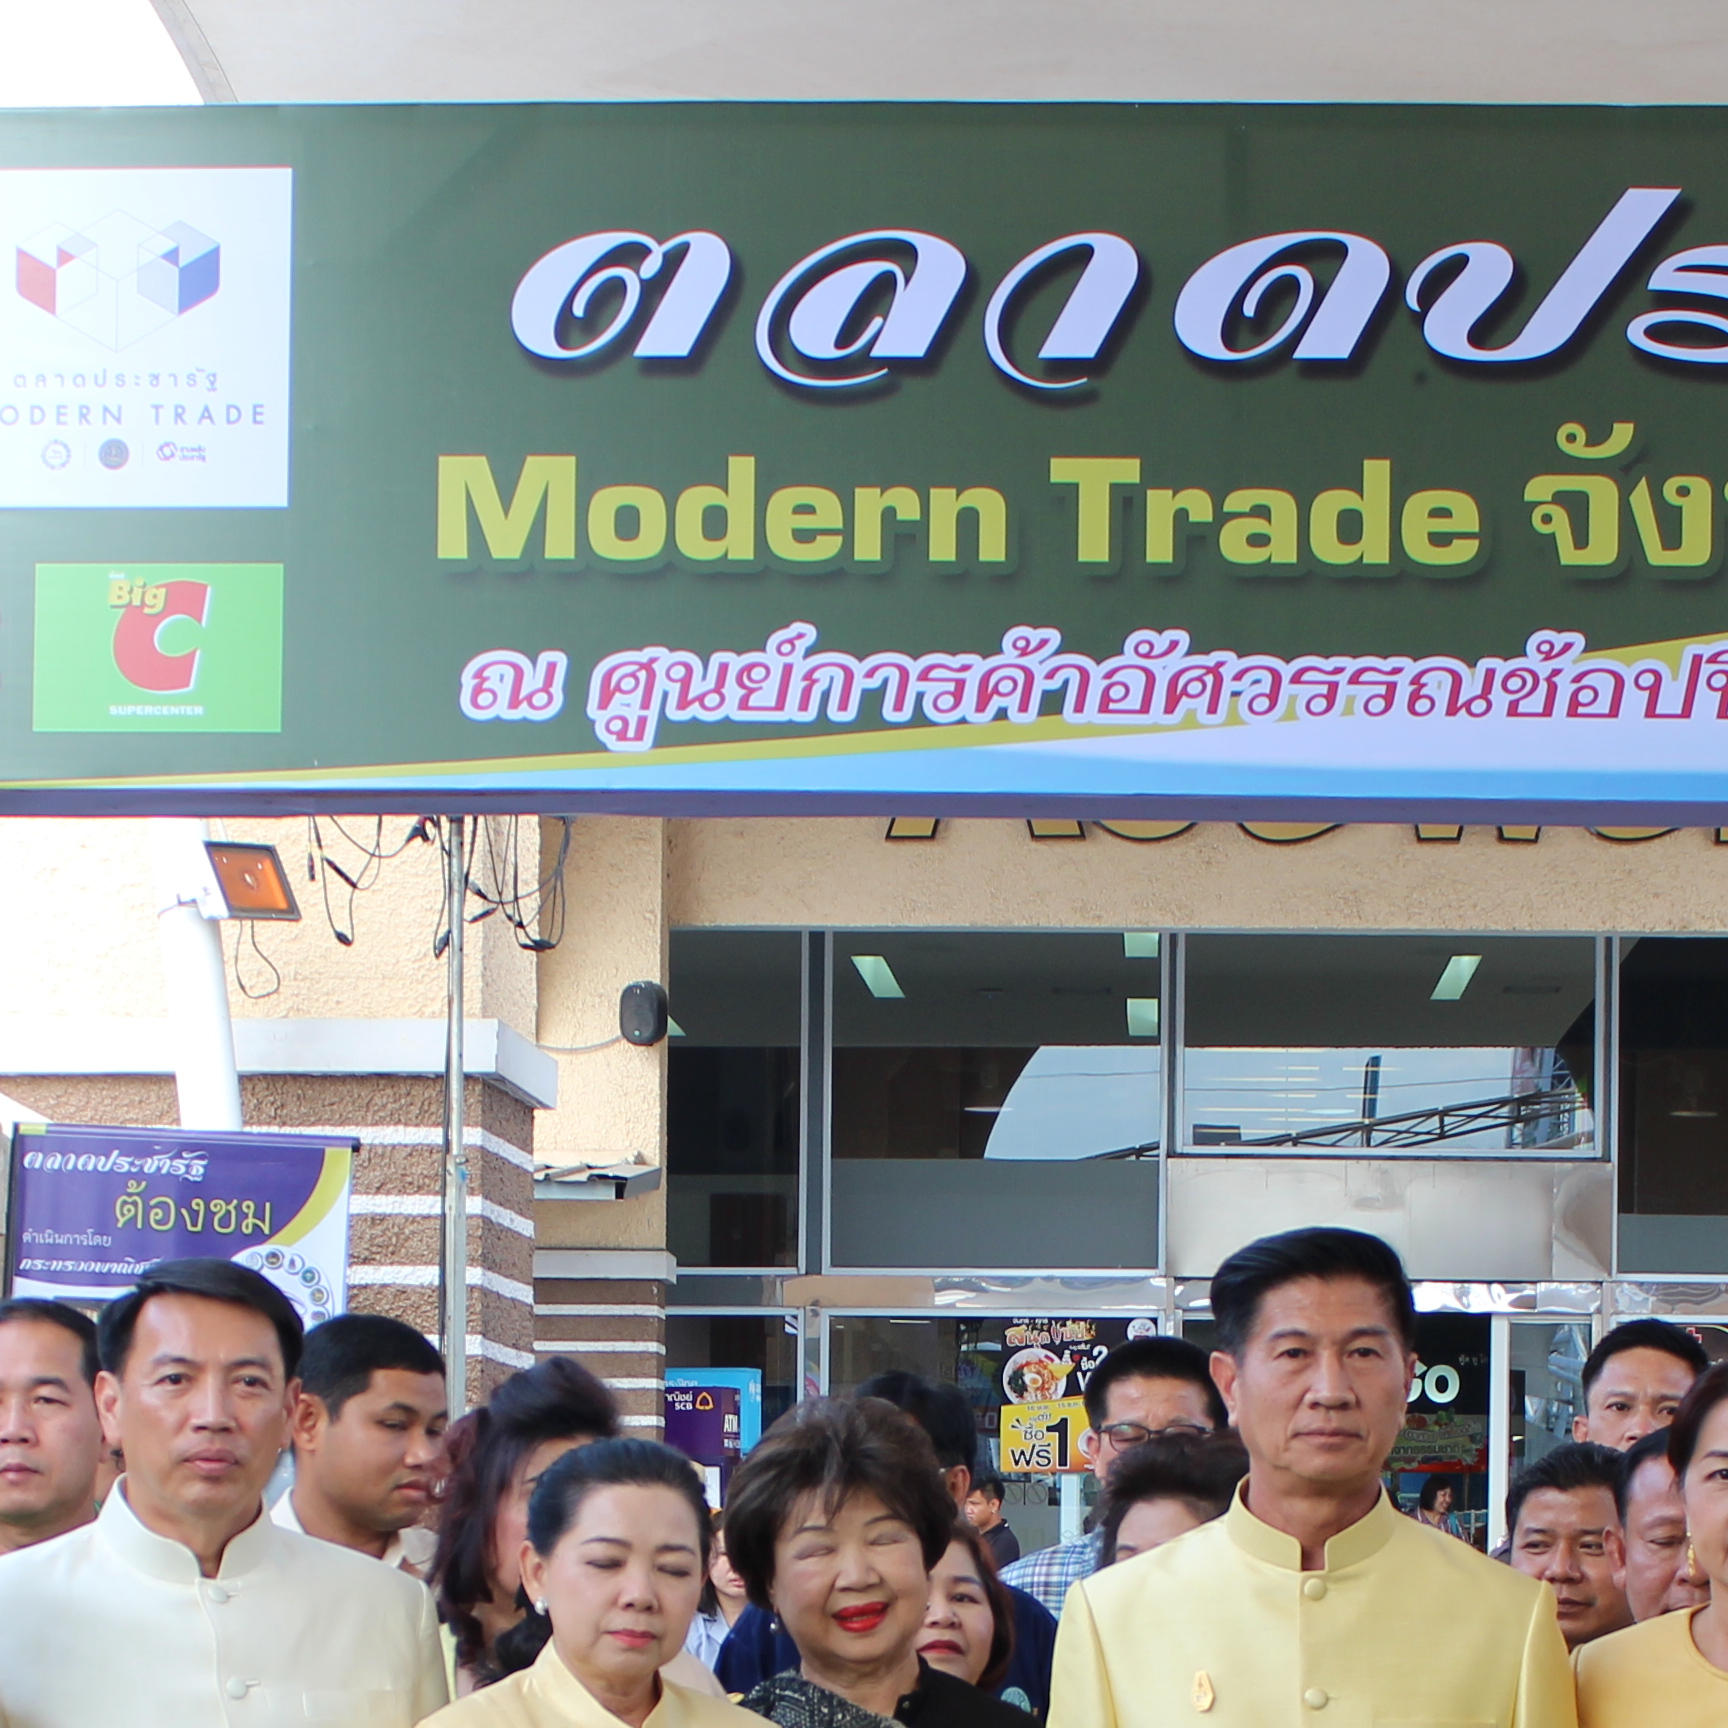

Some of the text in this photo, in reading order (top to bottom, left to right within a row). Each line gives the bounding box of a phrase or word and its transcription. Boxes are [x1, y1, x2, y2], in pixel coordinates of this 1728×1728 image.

[150, 403, 266, 426] TRADE
[435, 454, 1008, 563] Modern
[1049, 457, 1481, 566] Trade
[108, 577, 212, 694] Big C
[461, 646, 568, 724] ณ
[108, 704, 205, 716] SUPERCENTER
[114, 1178, 273, 1236] ต้องชม
[22, 1228, 113, 1248] ดำเนินการโดย
[674, 1402, 694, 1411] SCB
